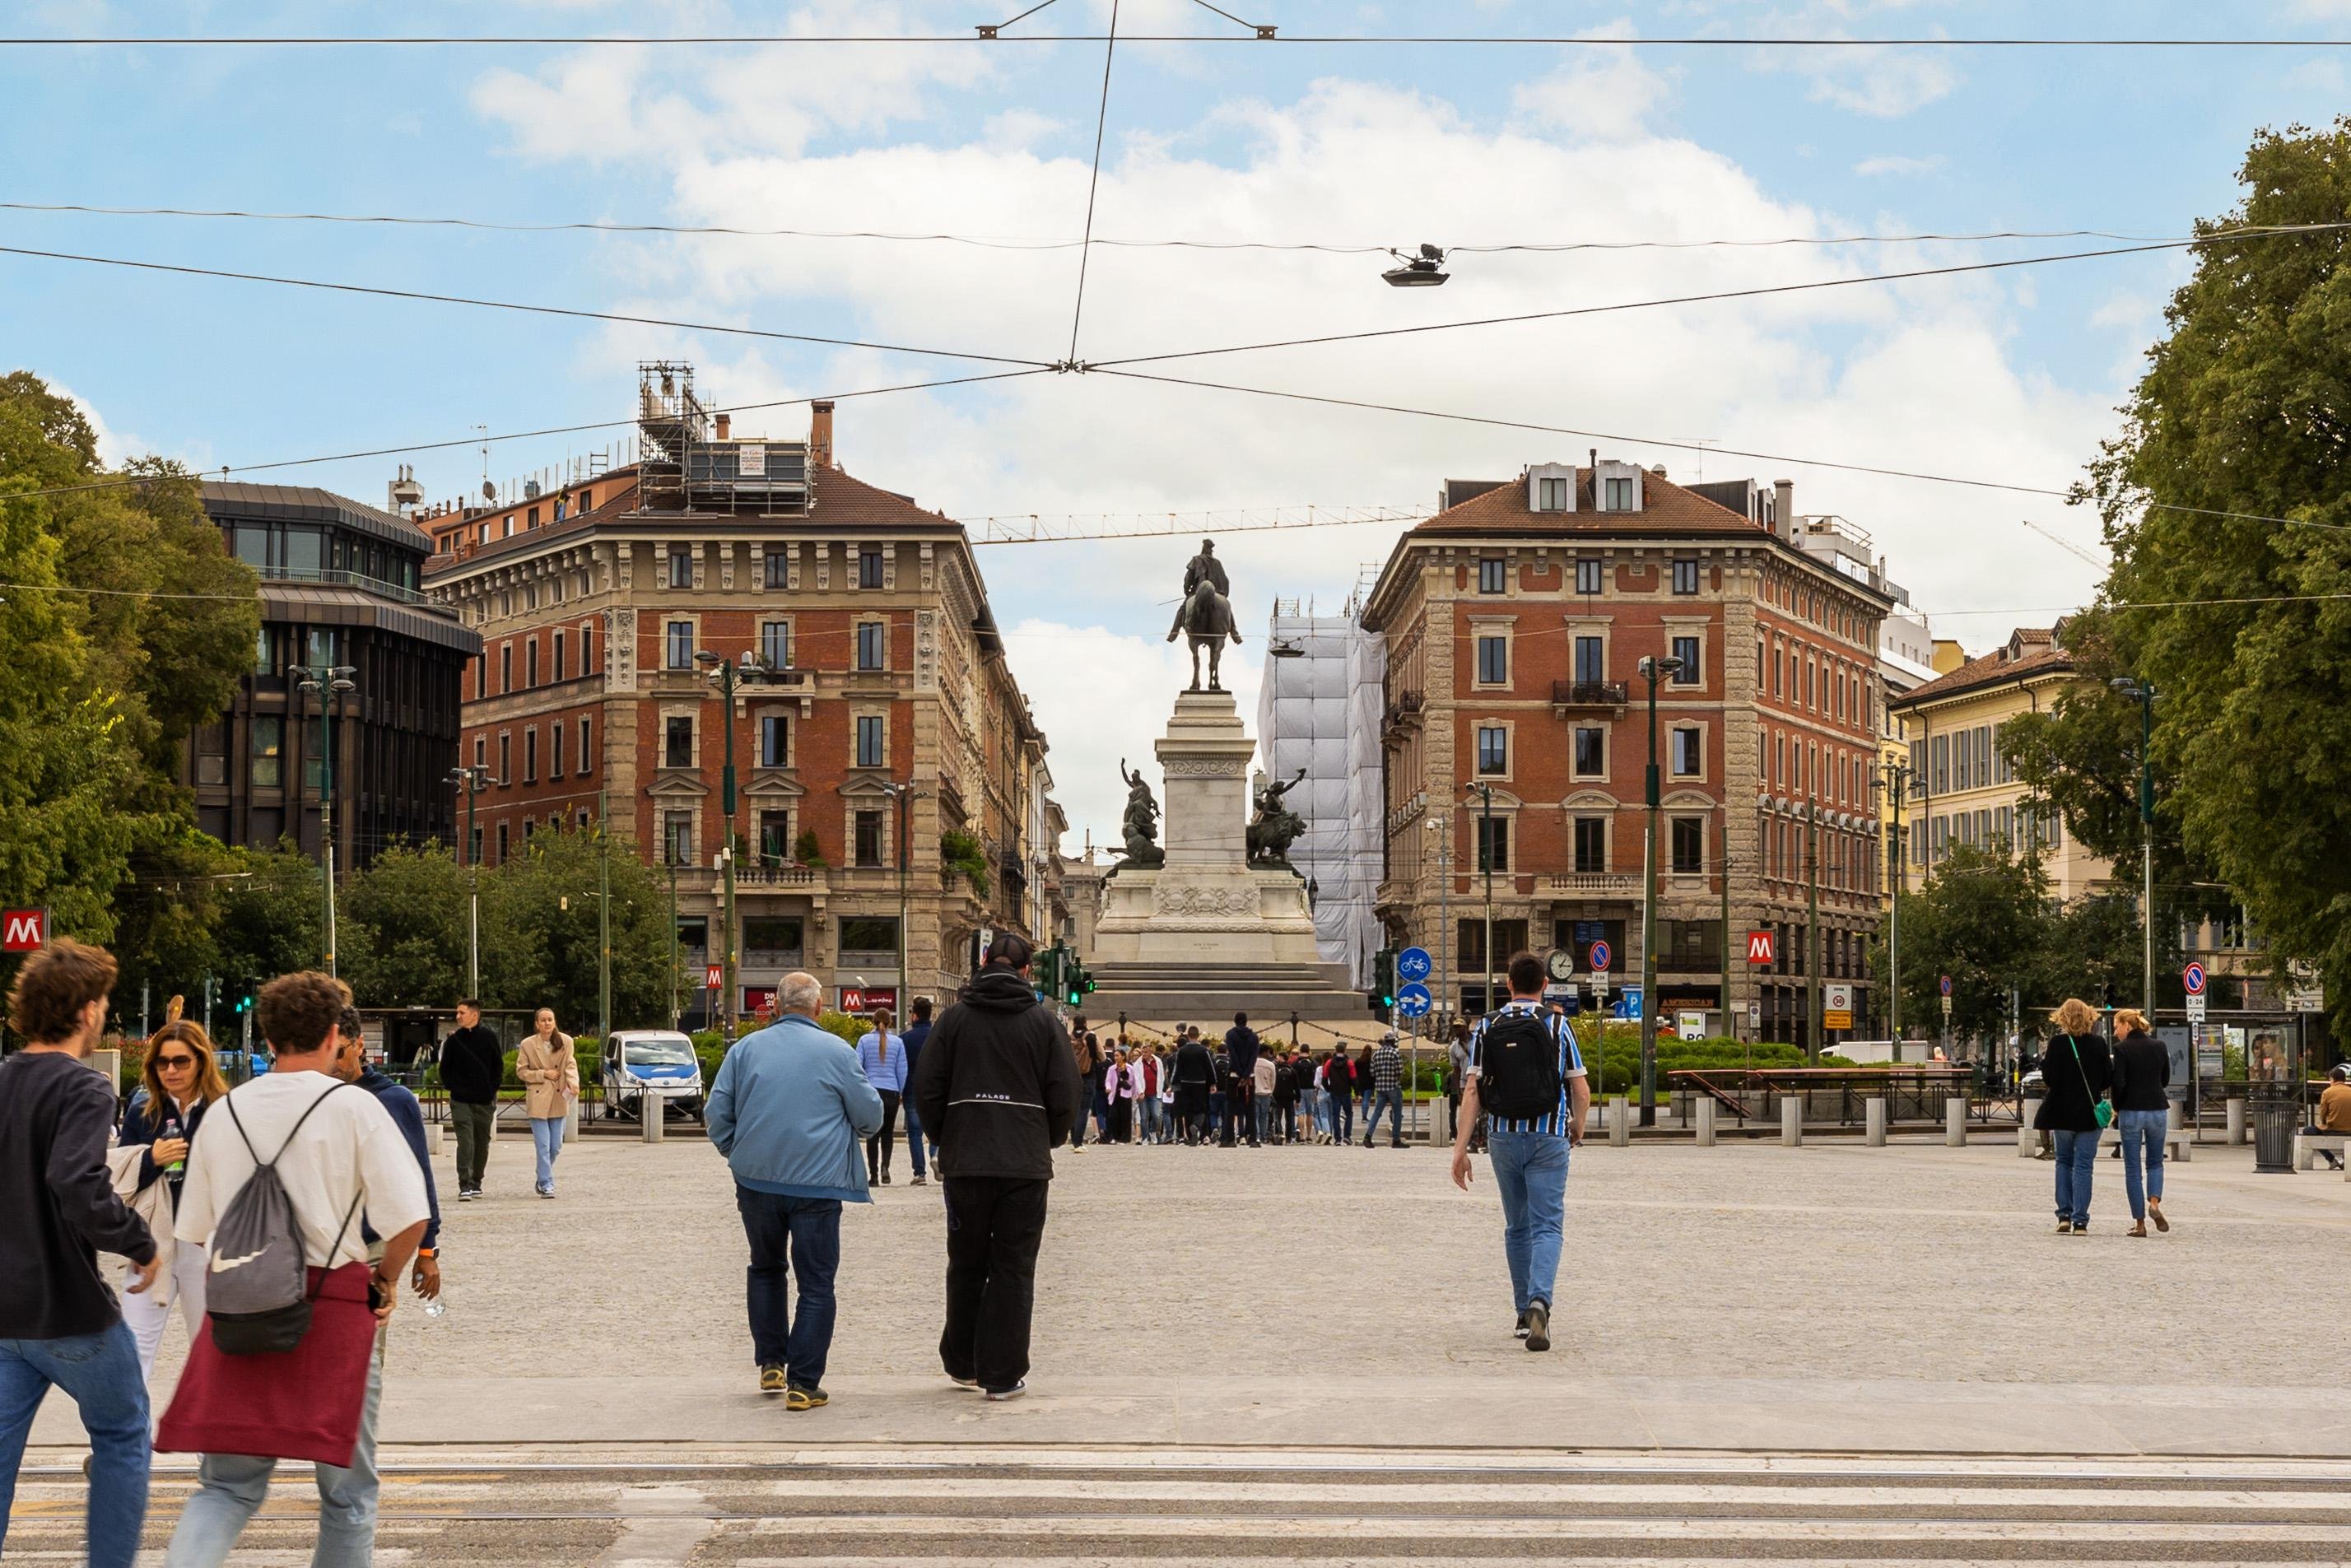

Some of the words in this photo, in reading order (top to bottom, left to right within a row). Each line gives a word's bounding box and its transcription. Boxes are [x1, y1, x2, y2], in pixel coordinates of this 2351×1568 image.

[6, 918, 40, 942] M
[1749, 938, 1771, 957] M
[708, 970, 721, 984] M
[845, 993, 859, 1006] M
[1631, 997, 1638, 1008] P
